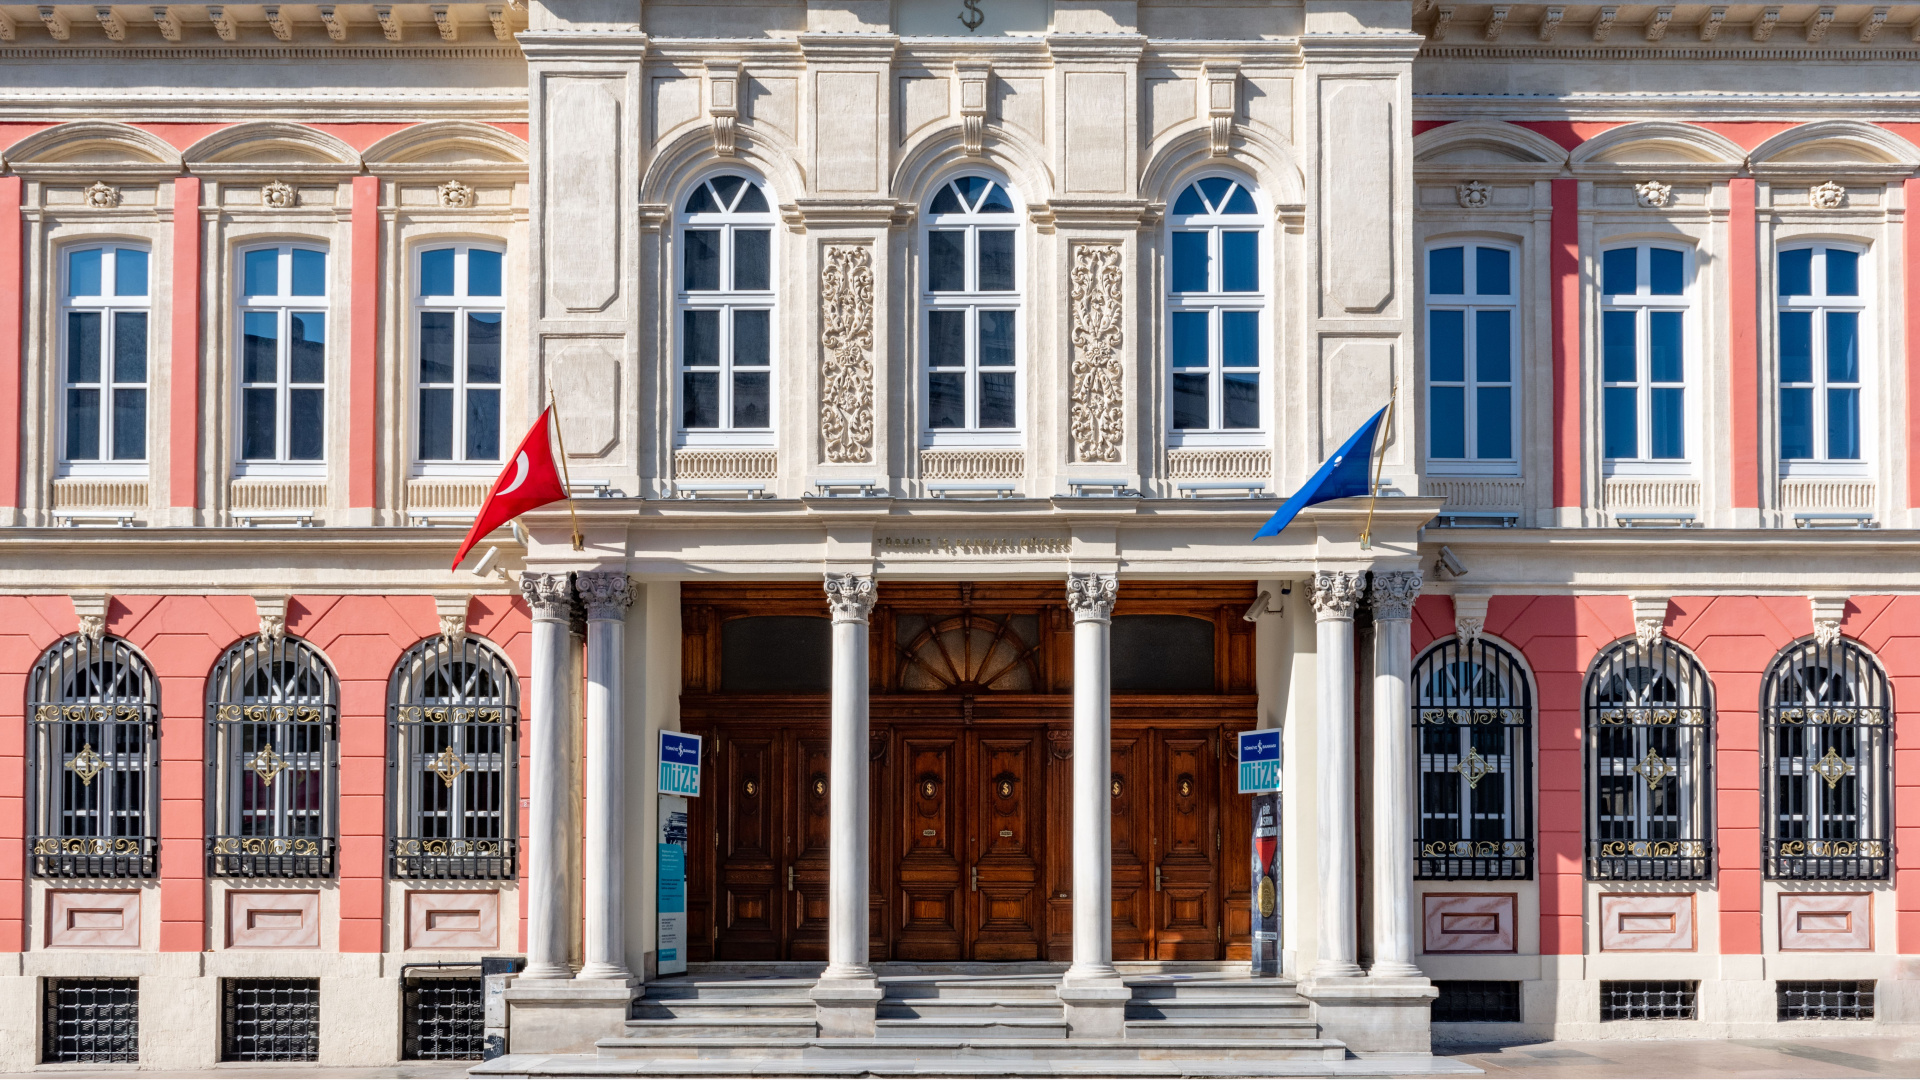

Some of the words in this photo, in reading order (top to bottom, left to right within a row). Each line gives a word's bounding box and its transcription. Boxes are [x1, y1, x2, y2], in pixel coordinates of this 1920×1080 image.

[877, 537, 931, 547] TÜRKİYE
[955, 538, 1012, 547] BANKASI
[660, 762, 699, 794] MÜZE
[1241, 760, 1280, 790] MÜZE
